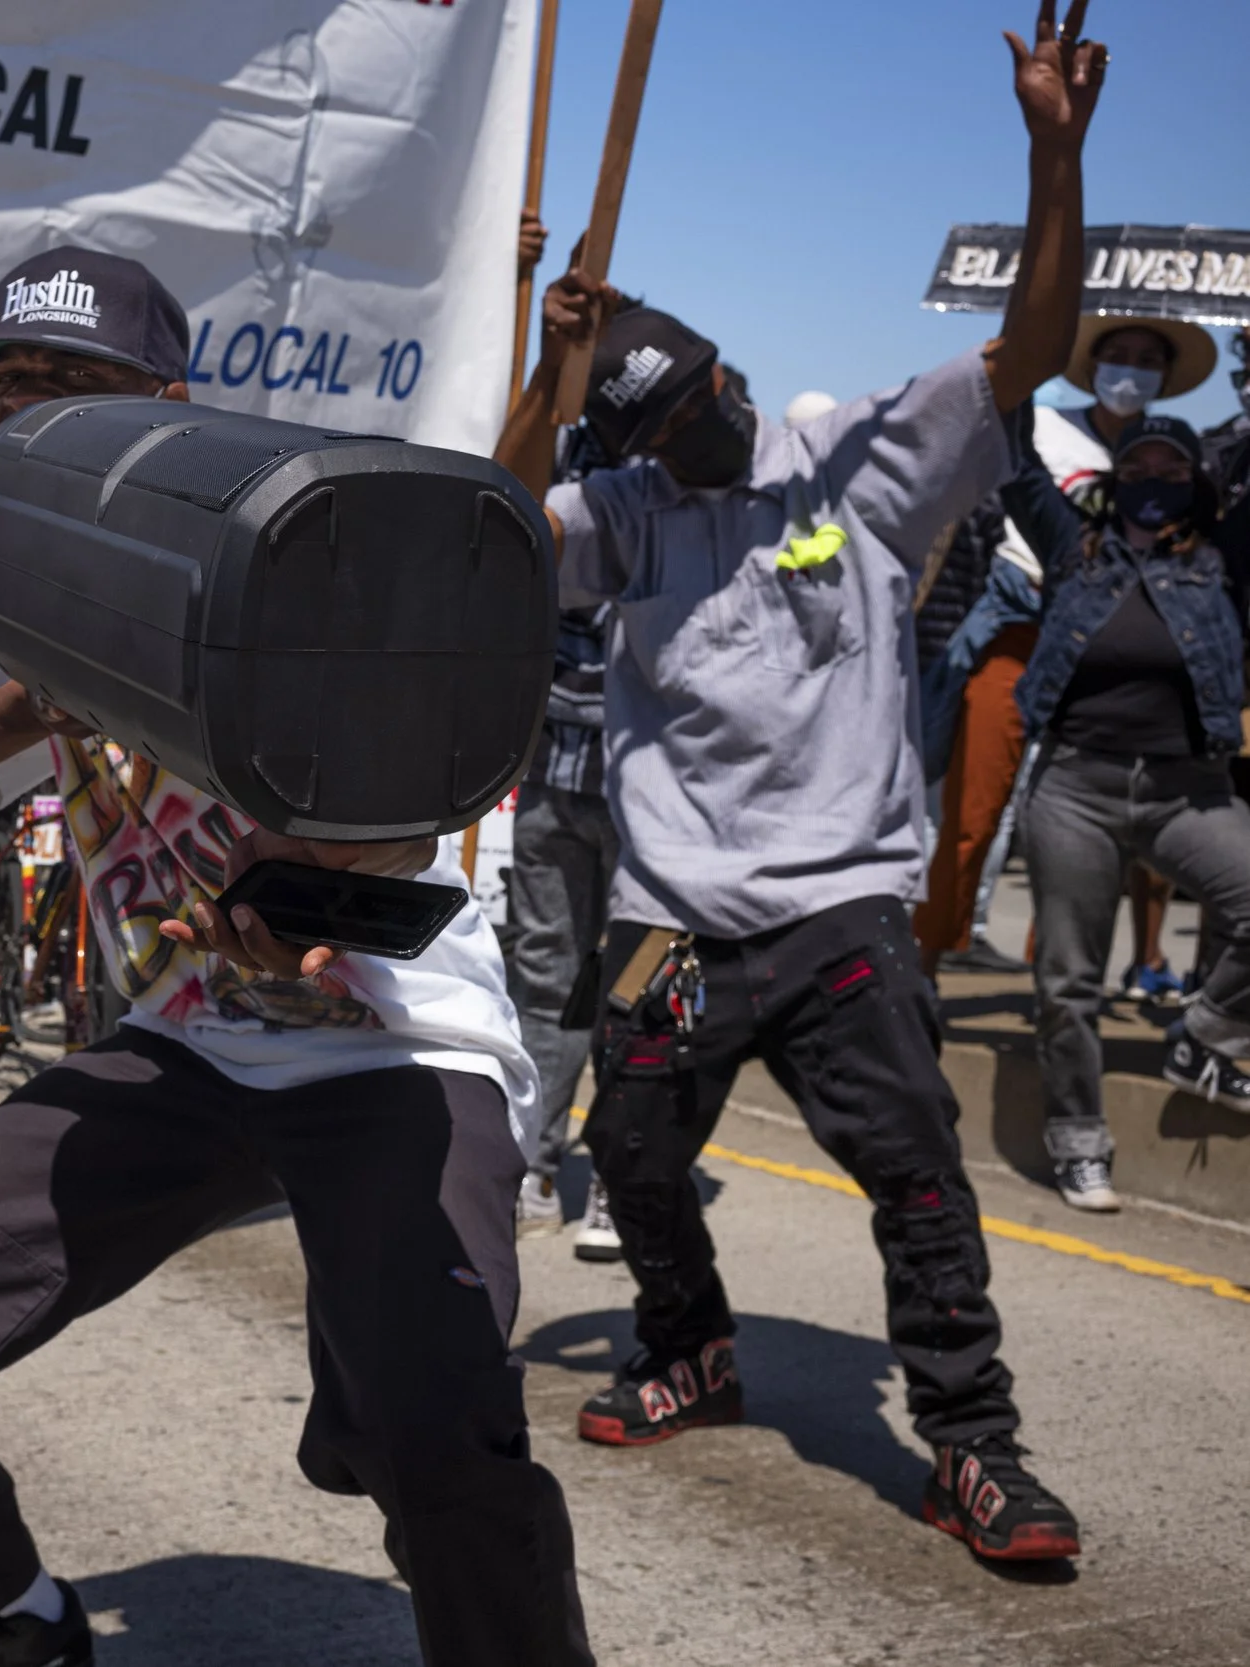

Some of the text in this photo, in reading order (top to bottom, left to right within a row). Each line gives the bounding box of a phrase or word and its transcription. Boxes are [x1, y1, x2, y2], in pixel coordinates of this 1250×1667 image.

[1083, 247, 1199, 292] LIVES
[1, 269, 101, 322] Hustlin
[17, 310, 98, 329] LONGSHORE
[187, 319, 351, 393] LOCAL
[377, 338, 423, 401] 10
